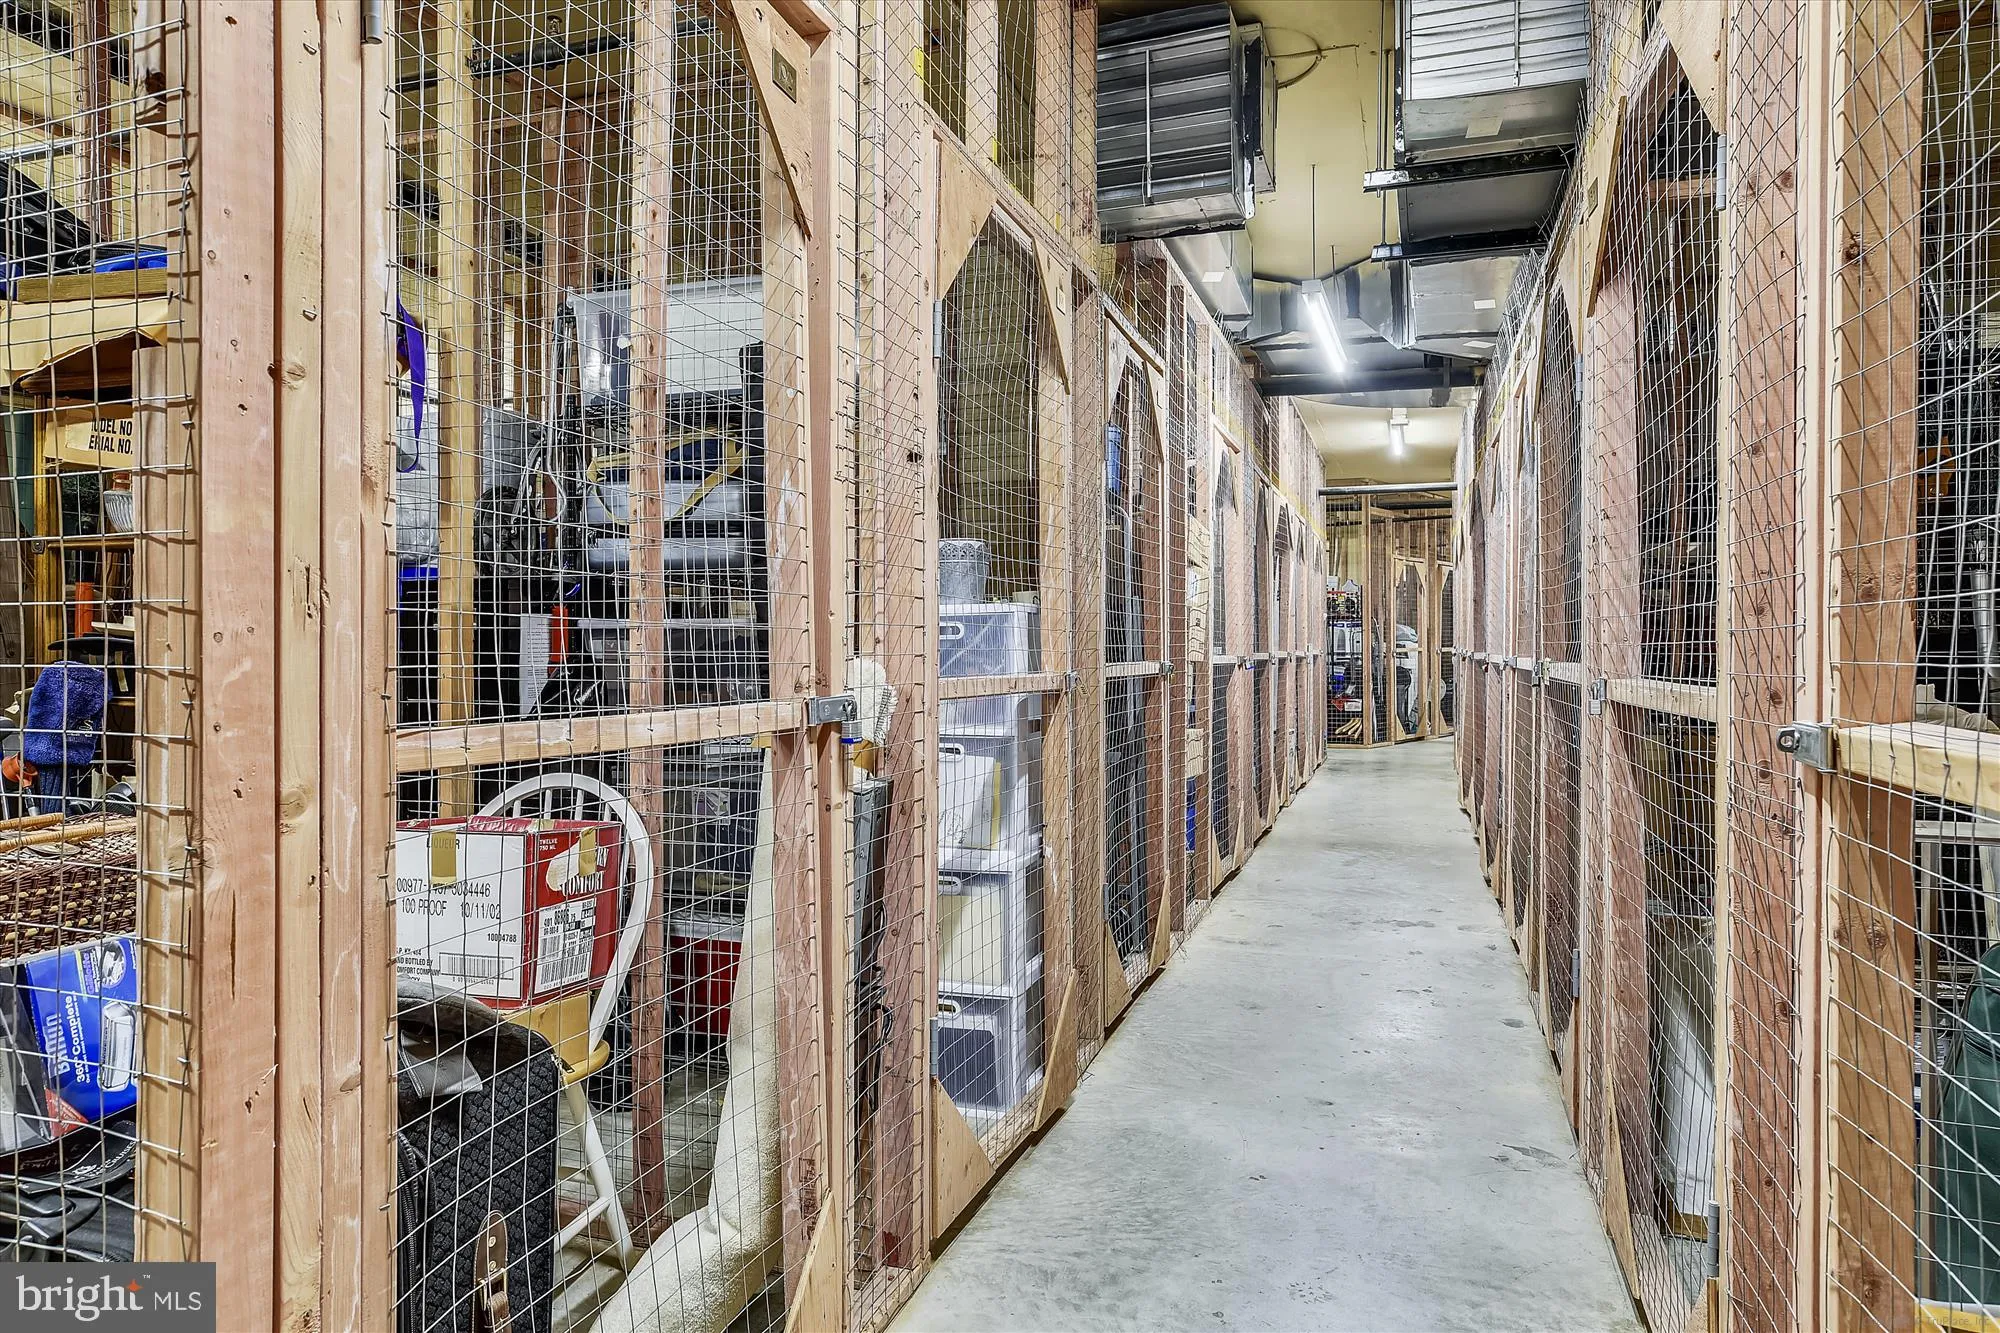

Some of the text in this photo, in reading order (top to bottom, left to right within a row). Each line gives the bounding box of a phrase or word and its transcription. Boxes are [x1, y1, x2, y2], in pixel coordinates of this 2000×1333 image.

[401, 897, 501, 920] 100 PROOF 10/11/02
